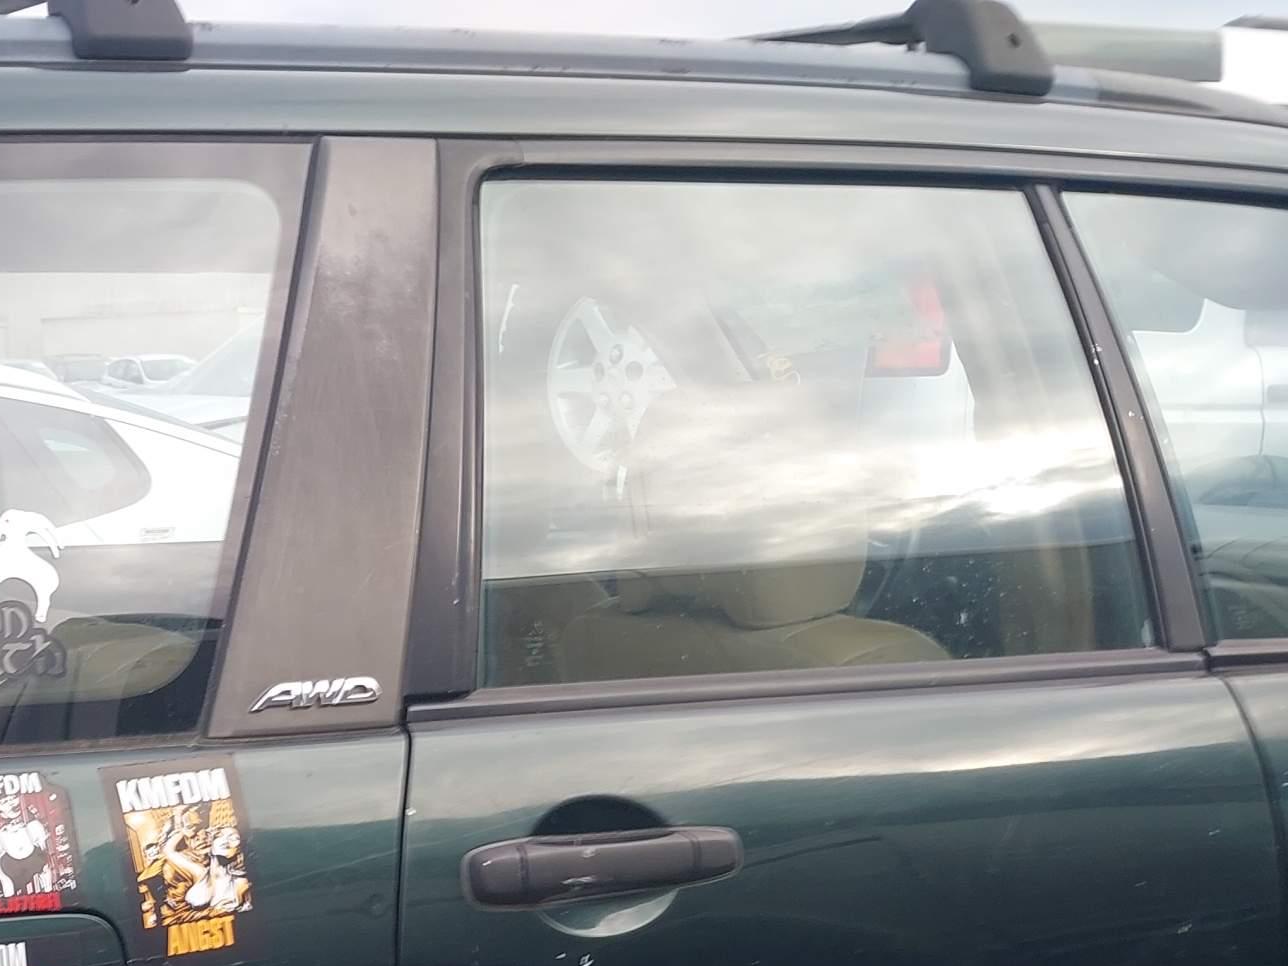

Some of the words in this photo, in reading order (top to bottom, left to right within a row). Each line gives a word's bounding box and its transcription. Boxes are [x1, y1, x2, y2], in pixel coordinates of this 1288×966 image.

[249, 677, 383, 713] AWD
[116, 767, 232, 813] KMFDM
[167, 914, 235, 957] ANGST
